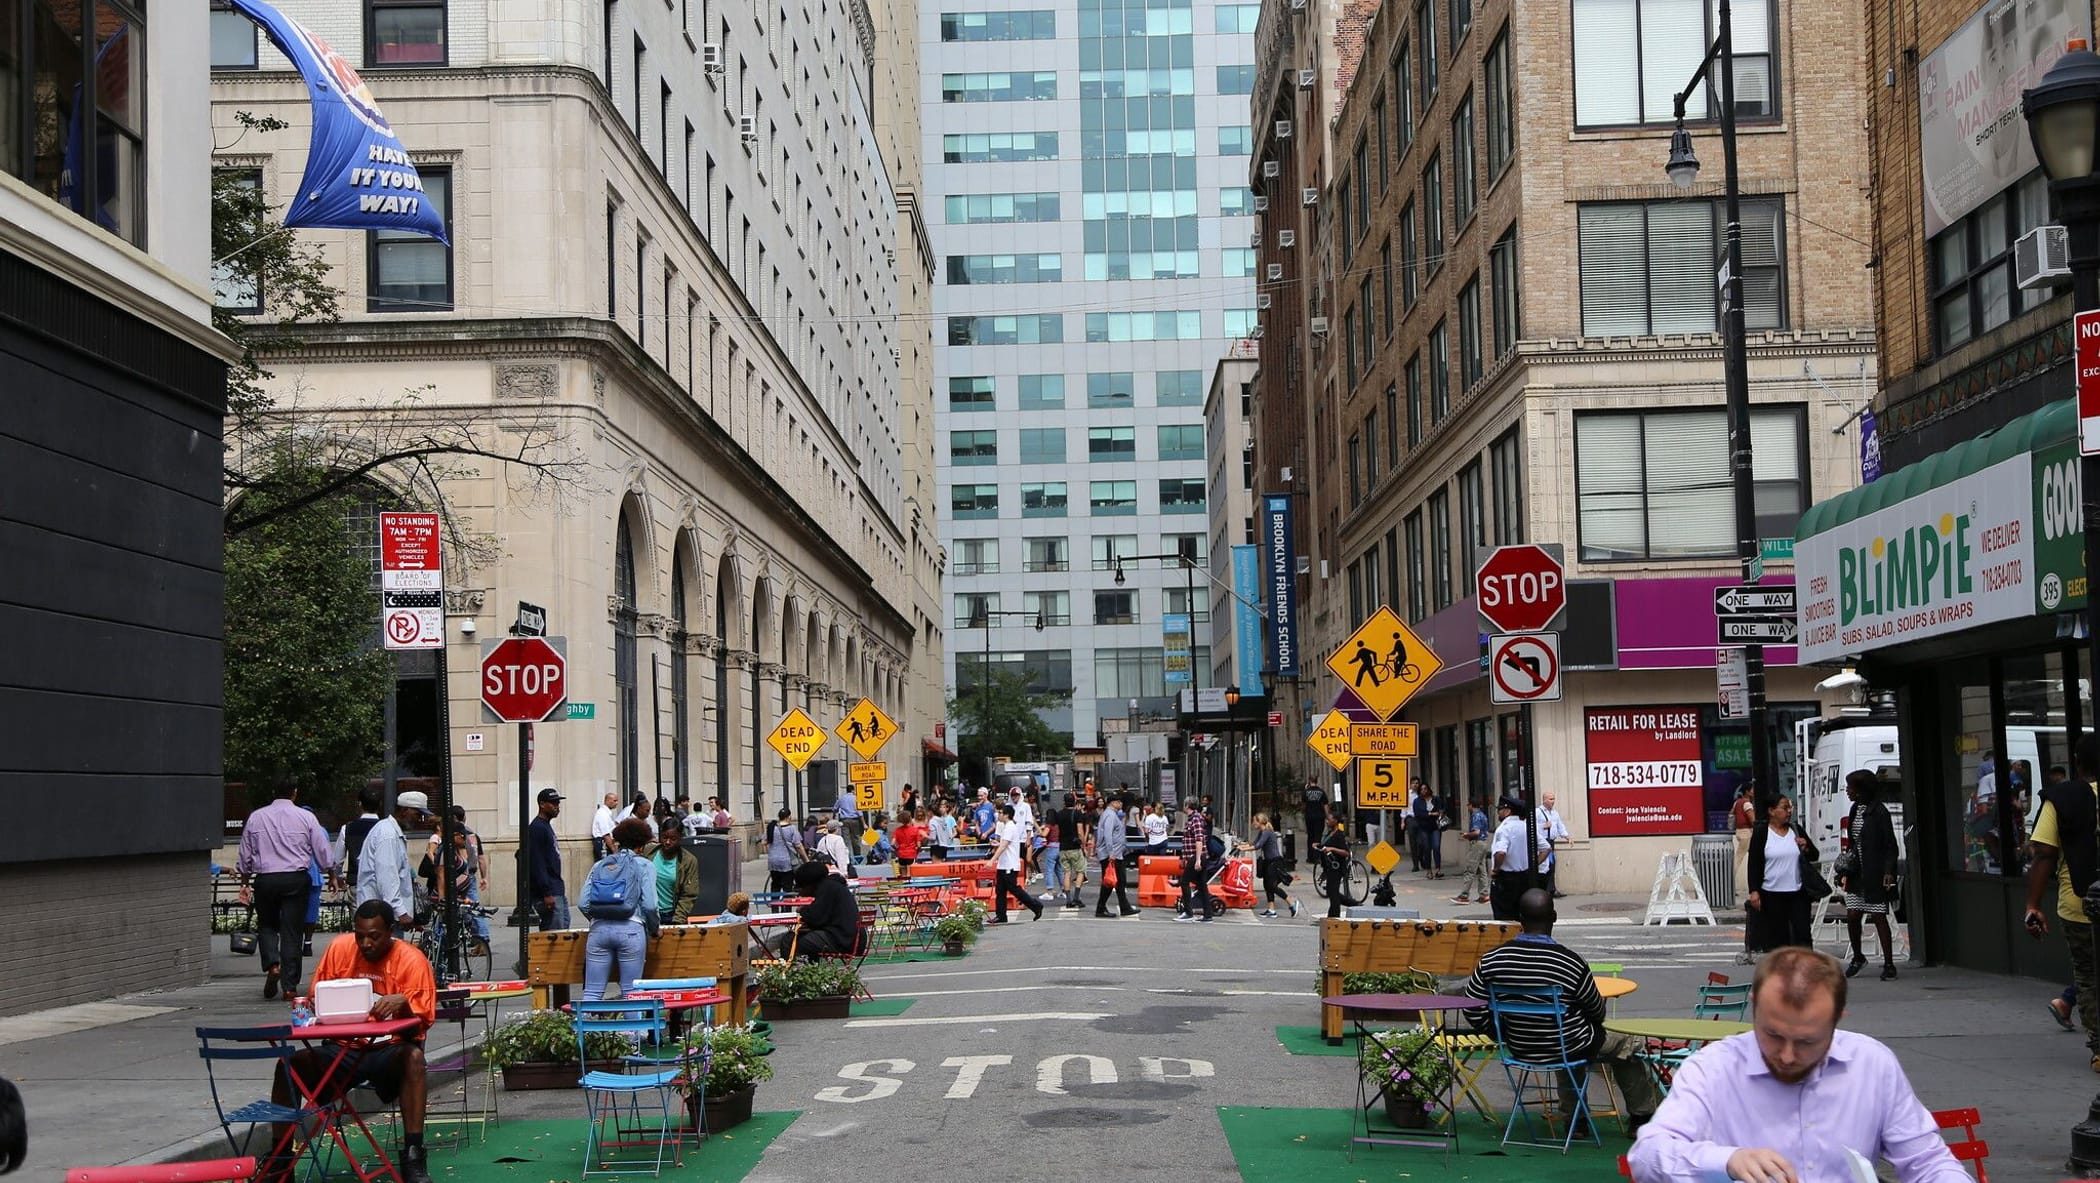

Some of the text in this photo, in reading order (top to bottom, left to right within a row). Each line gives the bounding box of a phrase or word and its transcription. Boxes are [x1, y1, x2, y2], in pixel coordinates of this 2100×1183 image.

[1945, 64, 1981, 112] PAIN
[1975, 121, 1998, 146] SHORT
[1999, 107, 2019, 130] TERM
[351, 167, 375, 188] IT
[359, 194, 418, 215] WAY!
[385, 517, 435, 526] NO STANDING
[390, 527, 407, 536] 7AM
[415, 527, 432, 536] 7PM
[1980, 519, 2021, 554] WE DELIVER
[1273, 513, 1290, 671] BROOKLYN FRIENDS SCHOOL
[1482, 571, 1559, 606] STOP
[1809, 576, 1828, 597] FRESH
[2043, 581, 2059, 601] 395
[1725, 594, 1790, 606] ONE WAY
[1804, 598, 1835, 623] SMOOTHIES
[1731, 624, 1794, 635] ONE WAY
[1824, 623, 1837, 642] BAR
[1841, 601, 1973, 647] SUBS, SALAD, SOUPS & WRAPS
[486, 664, 560, 696] STOP
[1589, 713, 1697, 731] RETAIL FOR LEASE
[780, 726, 815, 738] DEAD
[1320, 727, 1350, 739] DEA
[1357, 727, 1409, 738] SHARE THE
[1655, 730, 1697, 742] by Landlord
[786, 742, 810, 753] END
[1370, 741, 1396, 751] ROAD
[1374, 763, 1394, 788] 5
[1593, 763, 1697, 785] 718-534-0779
[863, 785, 875, 799] 5
[1366, 791, 1402, 802] M.P.H.
[1598, 805, 1667, 815] Contact: Jose Valencia
[814, 1053, 1216, 1104] STOP
